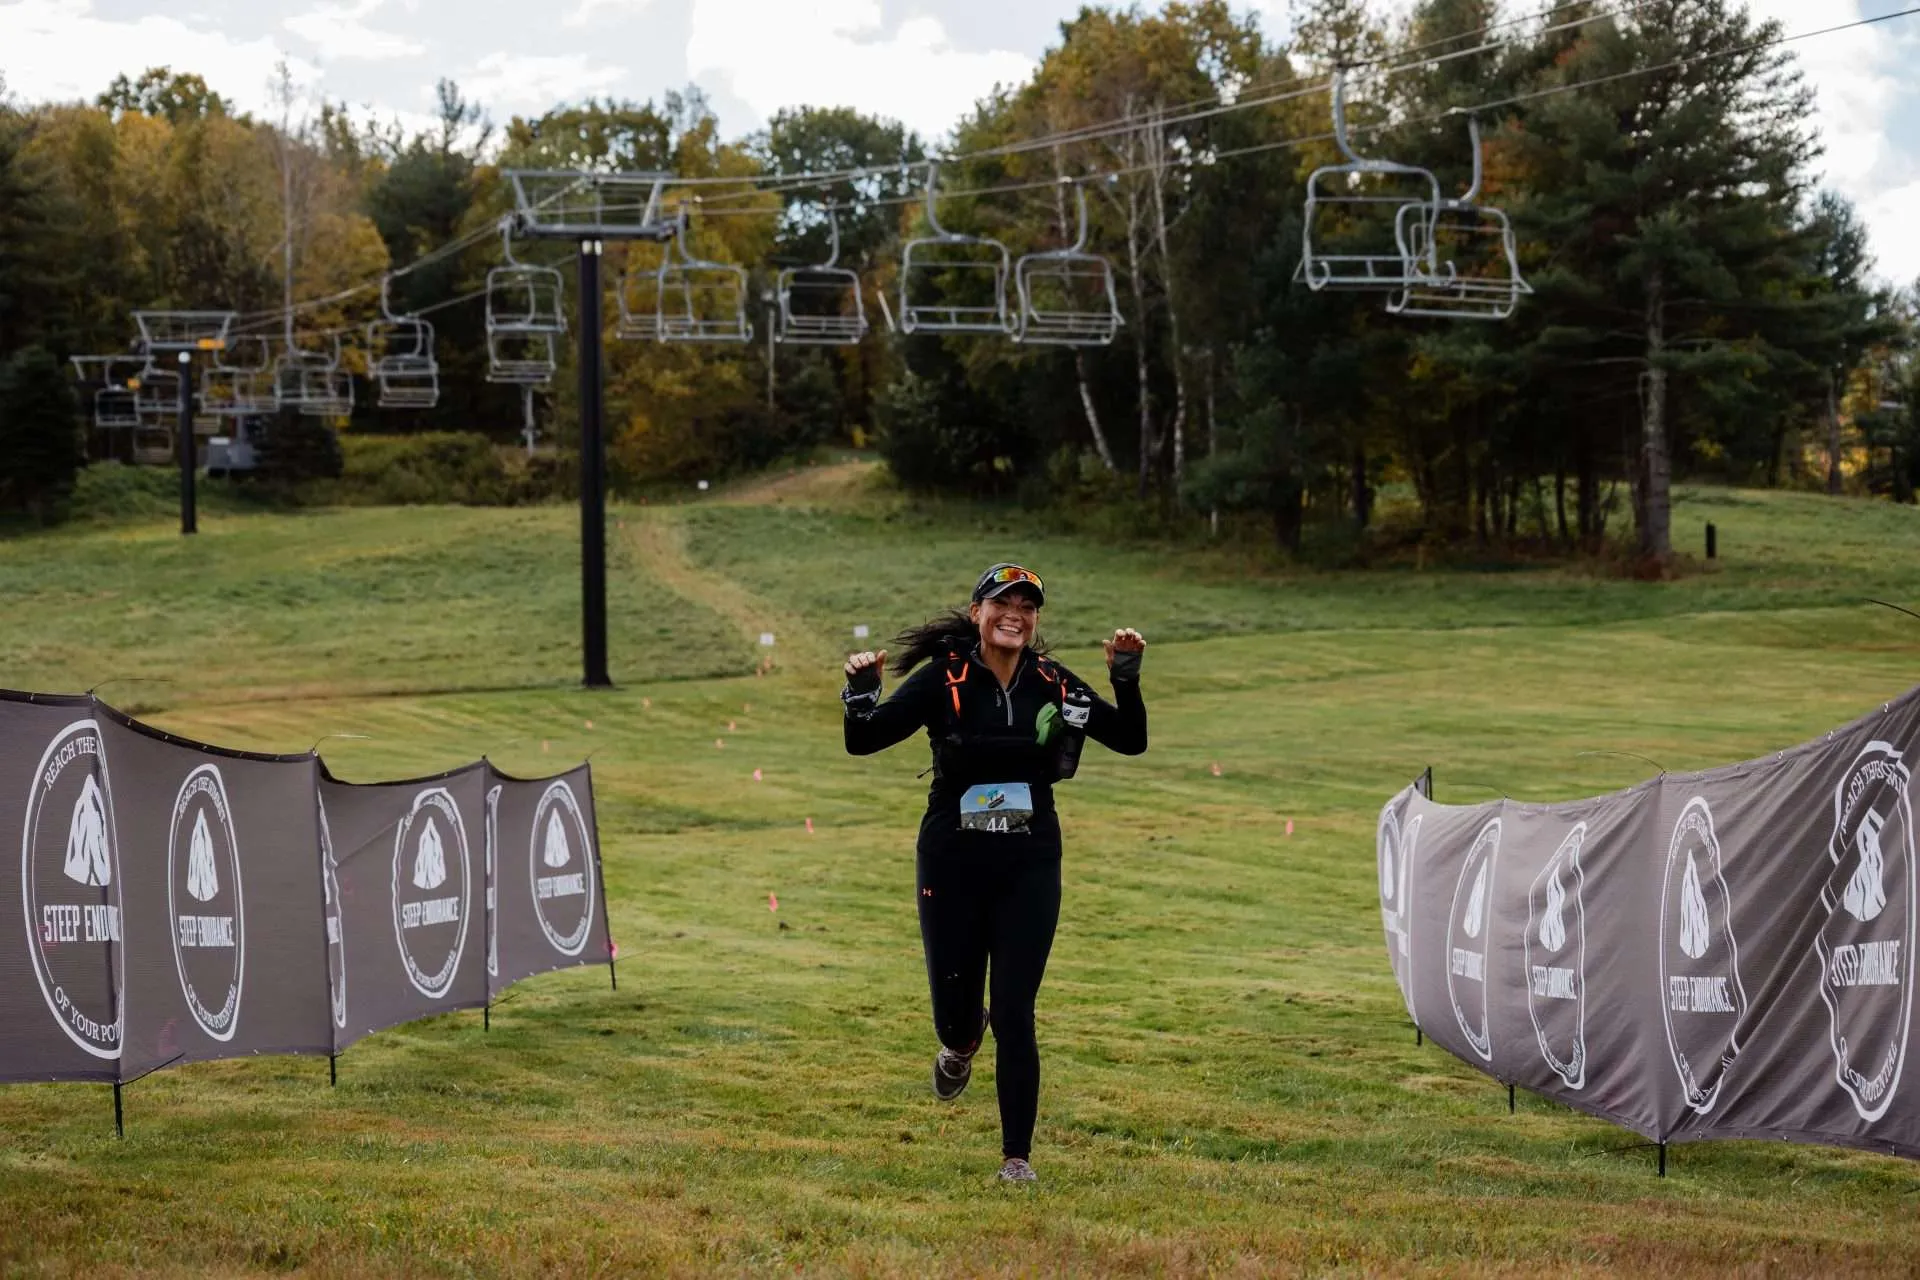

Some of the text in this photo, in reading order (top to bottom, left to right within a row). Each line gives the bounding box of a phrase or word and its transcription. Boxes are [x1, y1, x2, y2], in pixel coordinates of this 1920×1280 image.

[44, 740, 76, 791] REACH
[76, 736, 96, 755] THE
[986, 816, 1009, 833] 44
[44, 904, 80, 942] STEEP
[1831, 944, 1858, 987] STEEP
[55, 986, 70, 1012] OF
[71, 1005, 99, 1040] YOUR
[1670, 976, 1689, 1011] STEEP
